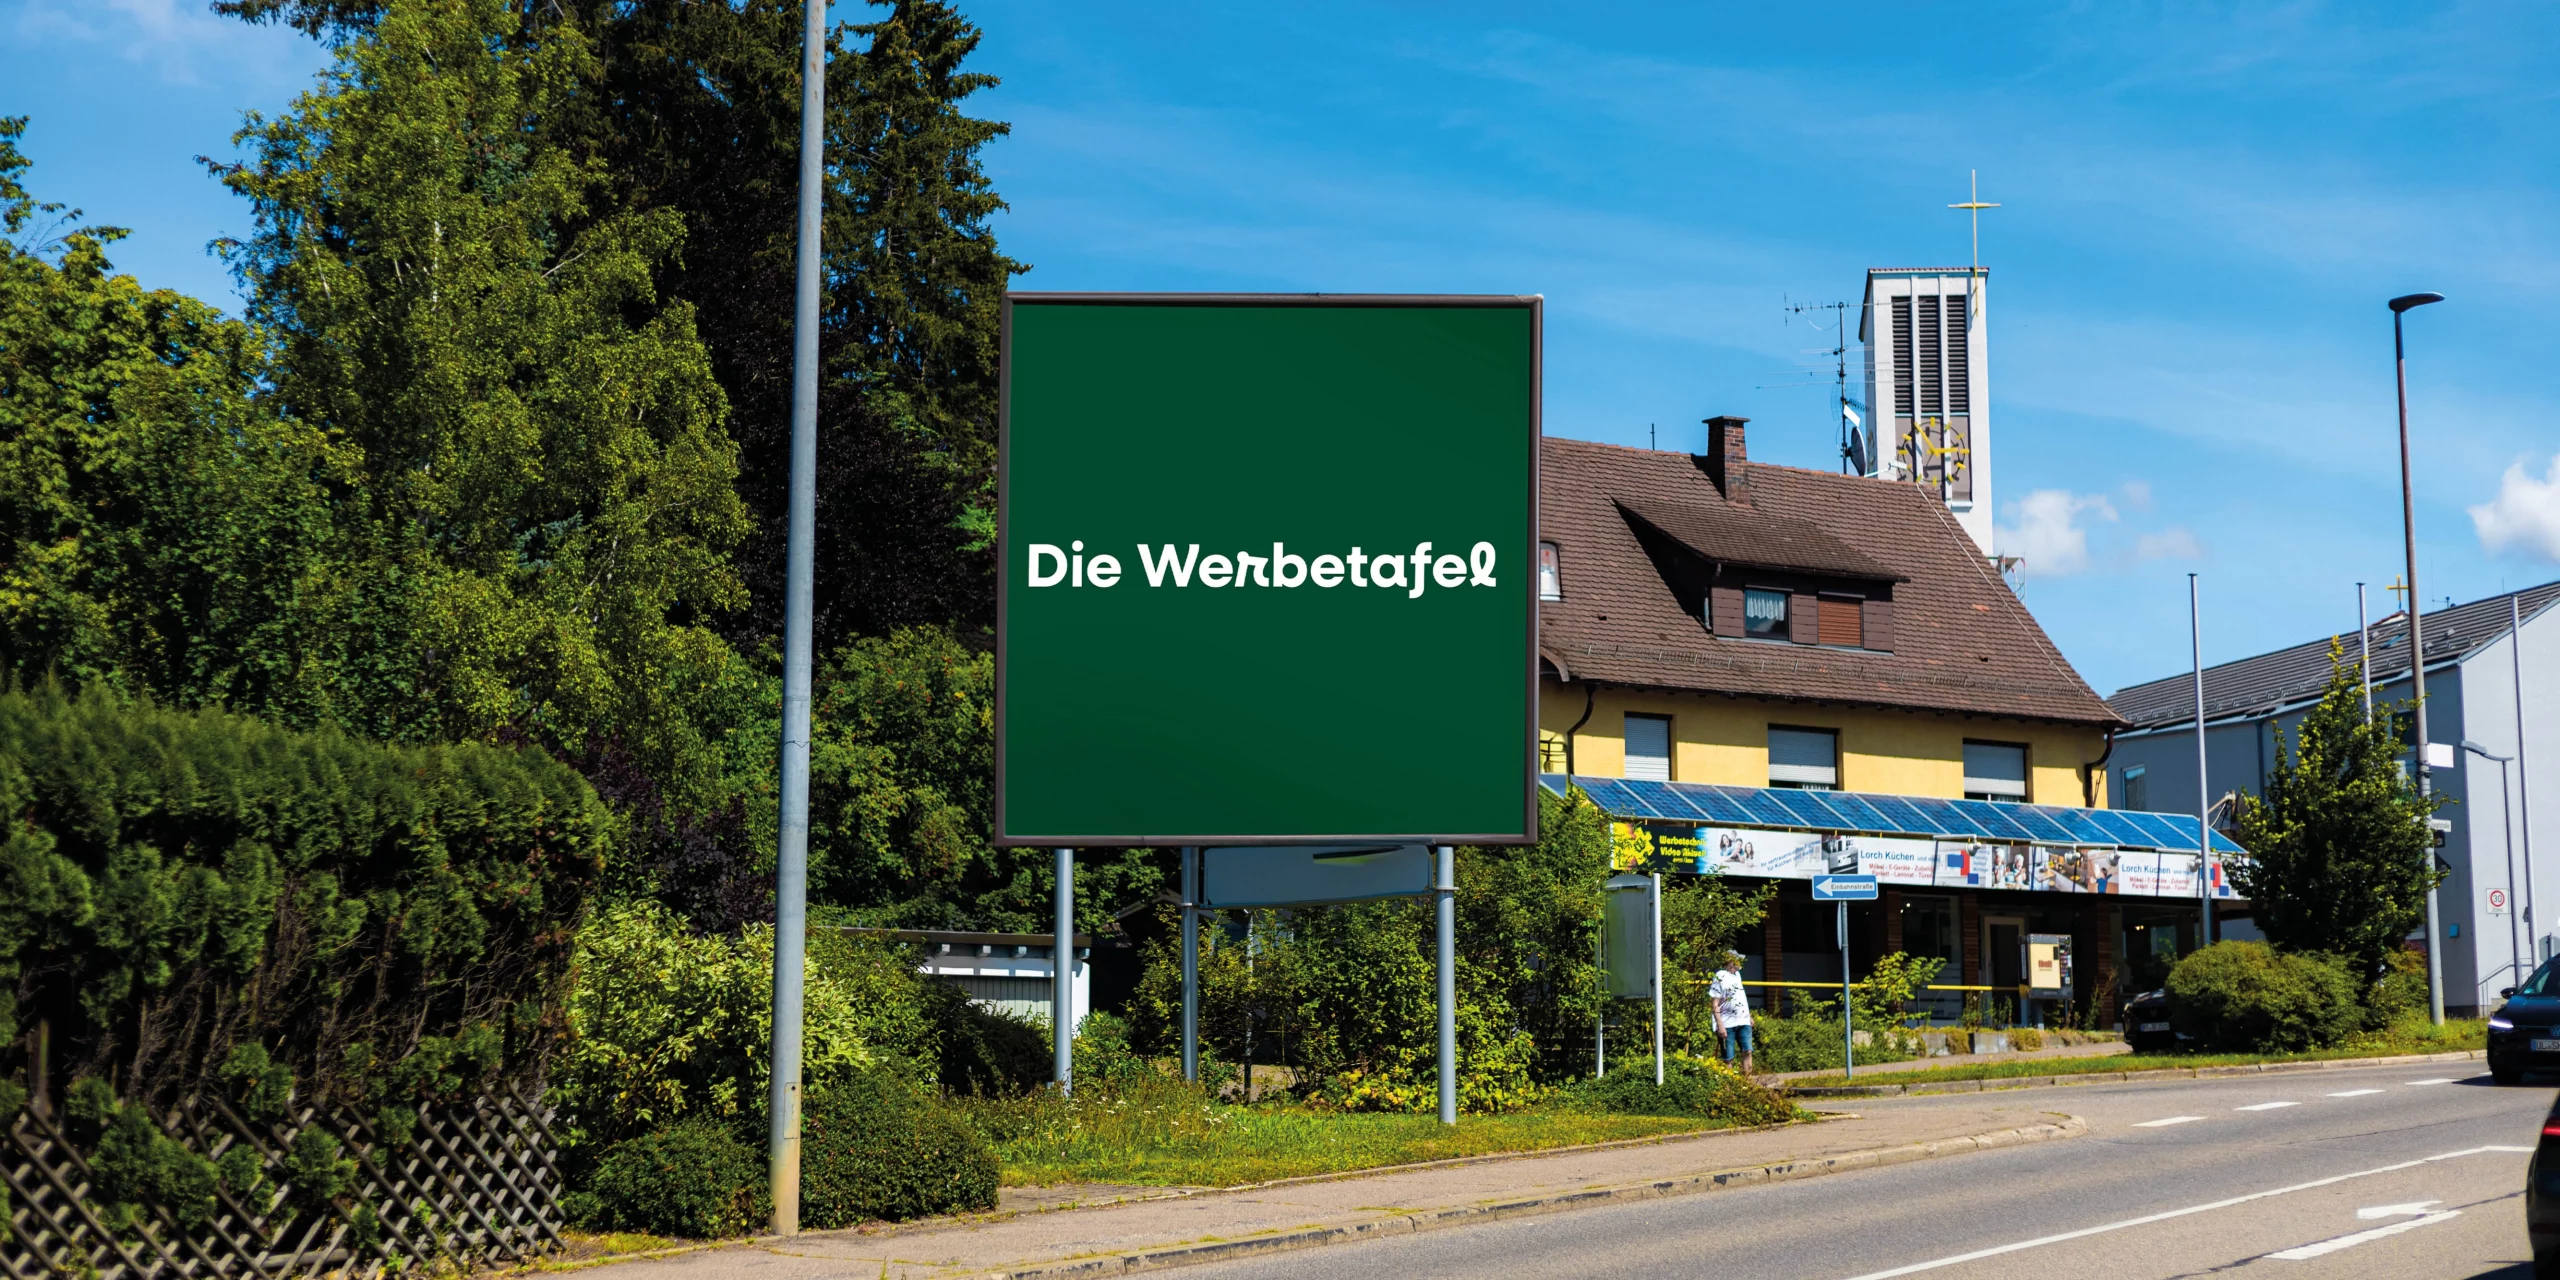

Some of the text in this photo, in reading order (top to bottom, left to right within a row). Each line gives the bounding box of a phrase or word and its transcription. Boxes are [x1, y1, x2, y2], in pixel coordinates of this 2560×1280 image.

[1029, 541, 1497, 599] Die Werbetafel
[1860, 850, 1883, 859] Lorch
[1885, 851, 1914, 861] Küchen
[2121, 864, 2142, 872] Lorch
[2493, 894, 2502, 903] 30
